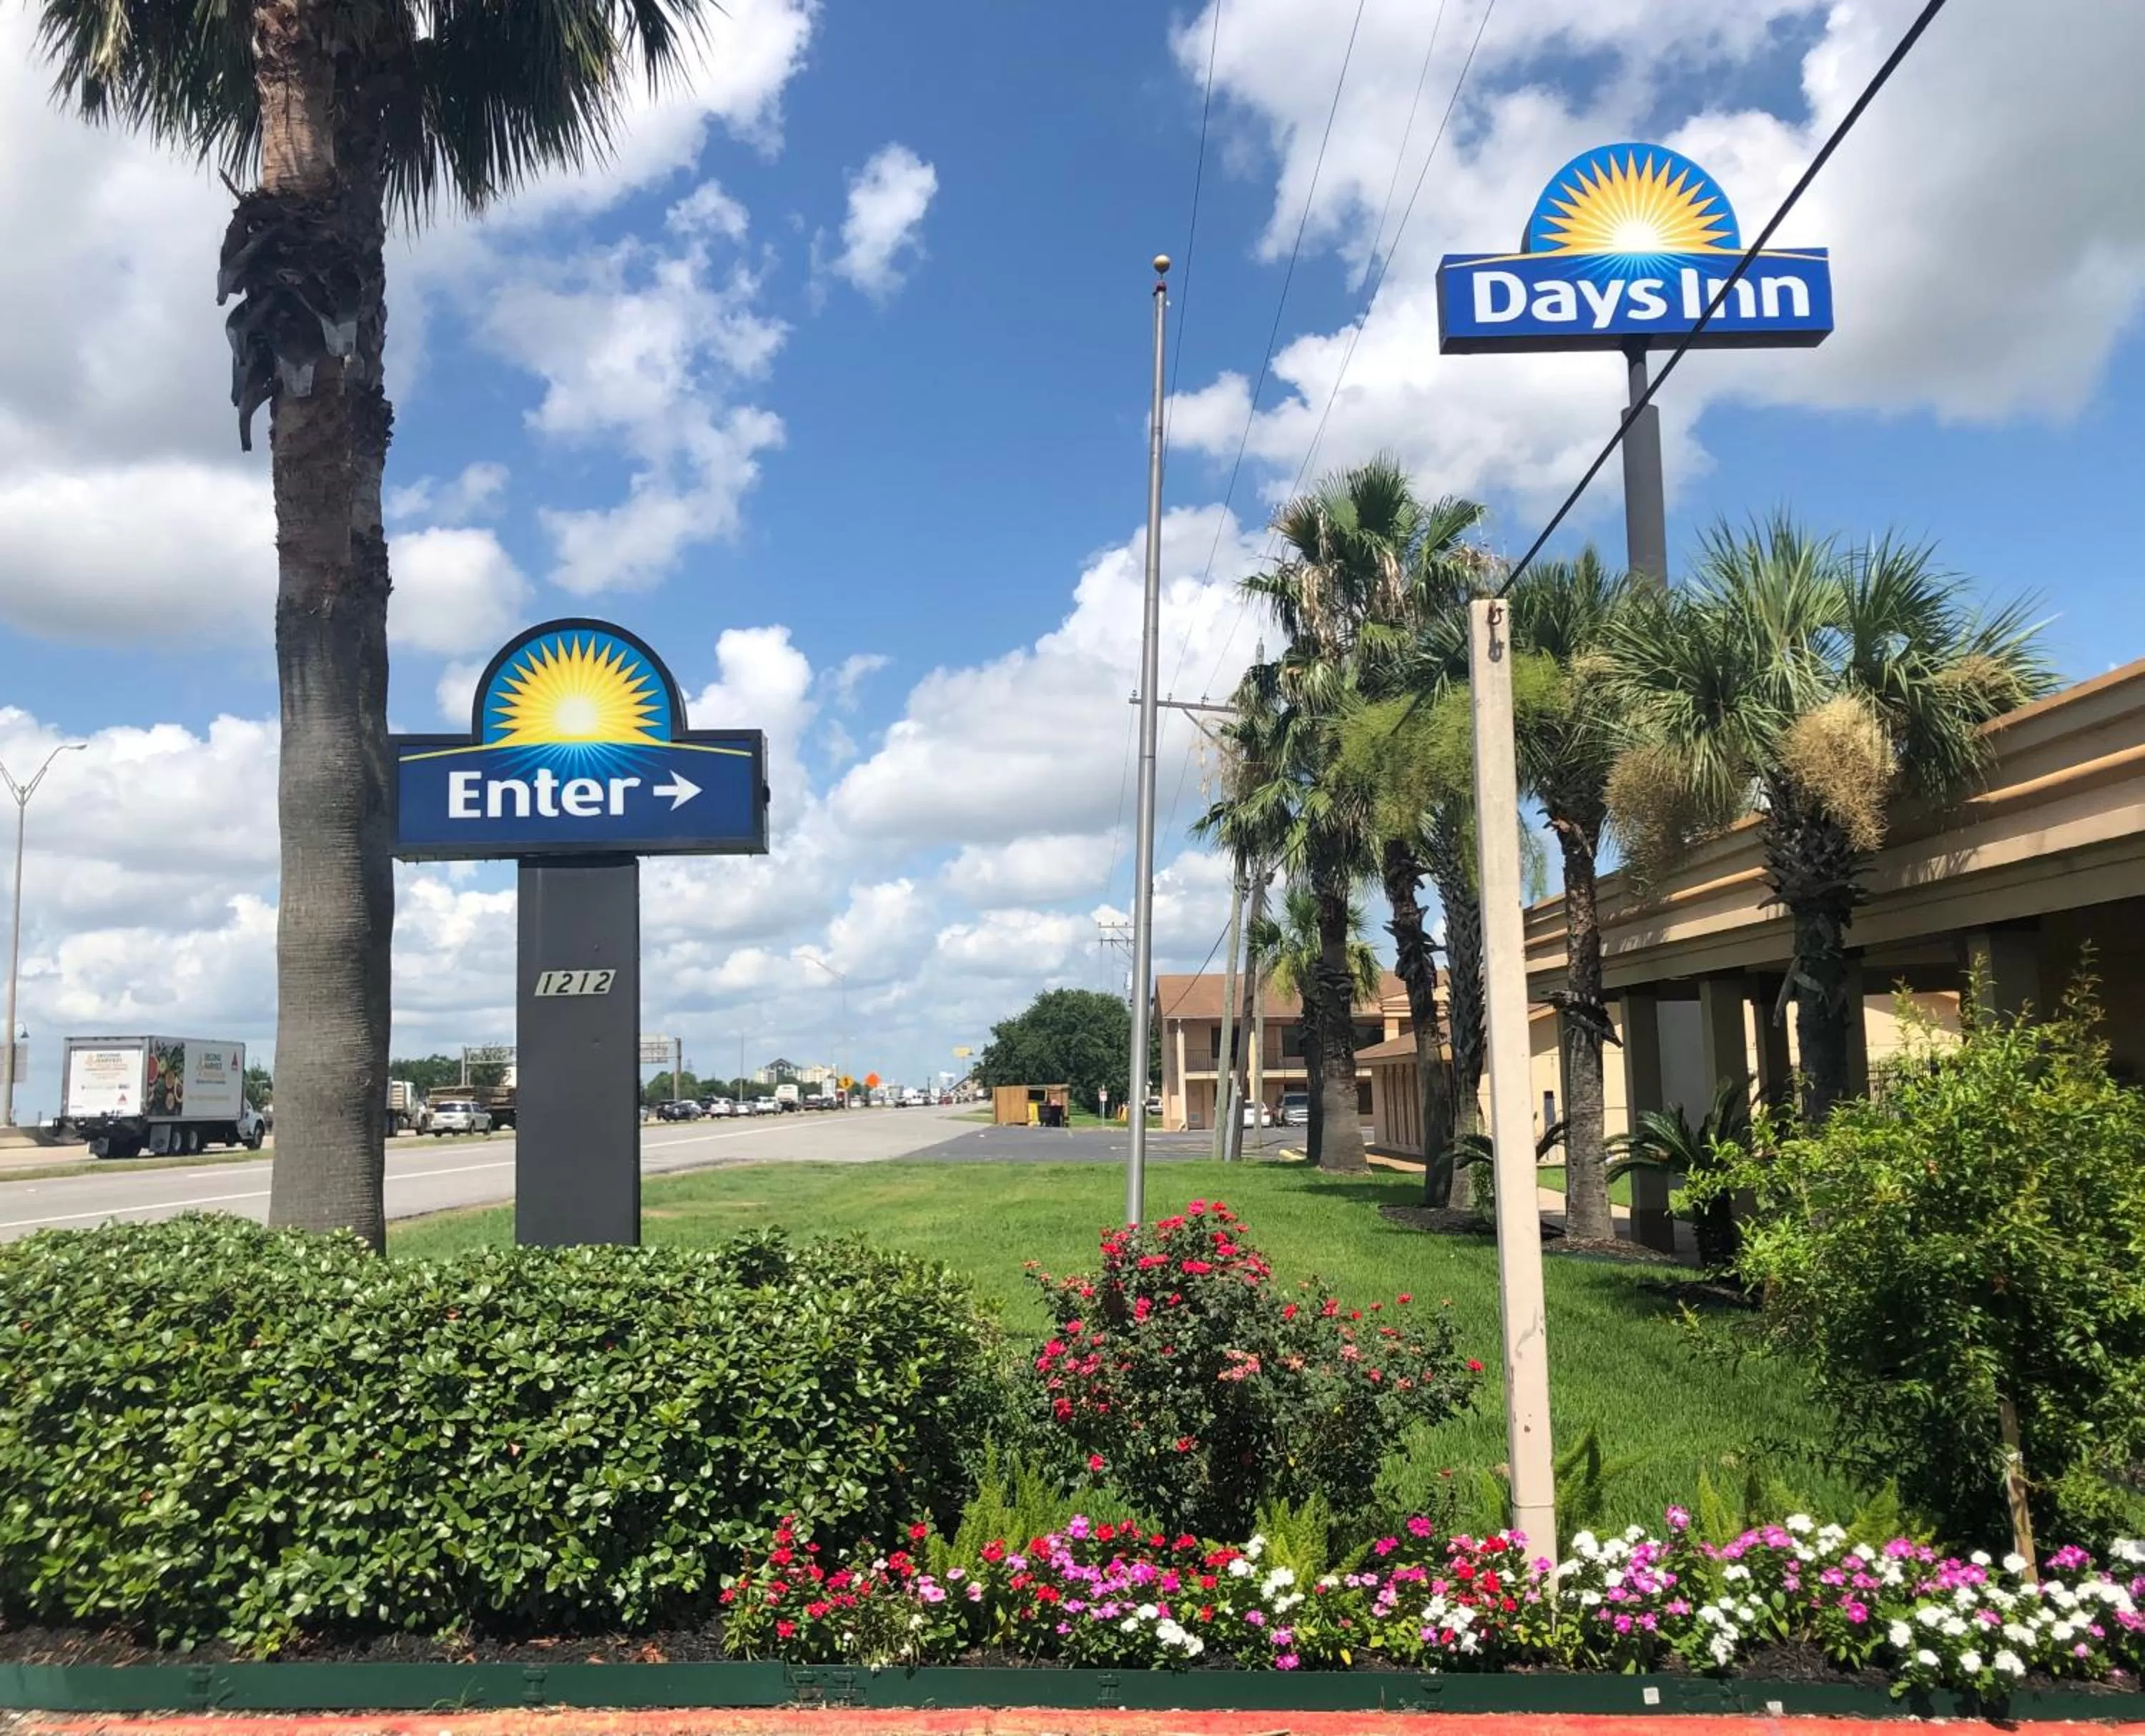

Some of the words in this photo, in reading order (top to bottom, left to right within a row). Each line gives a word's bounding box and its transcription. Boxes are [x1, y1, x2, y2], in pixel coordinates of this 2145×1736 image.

[1472, 271, 1667, 329] Days
[1681, 268, 1810, 320] Inn
[448, 769, 641, 818] Enter
[542, 971, 611, 995] 1212
